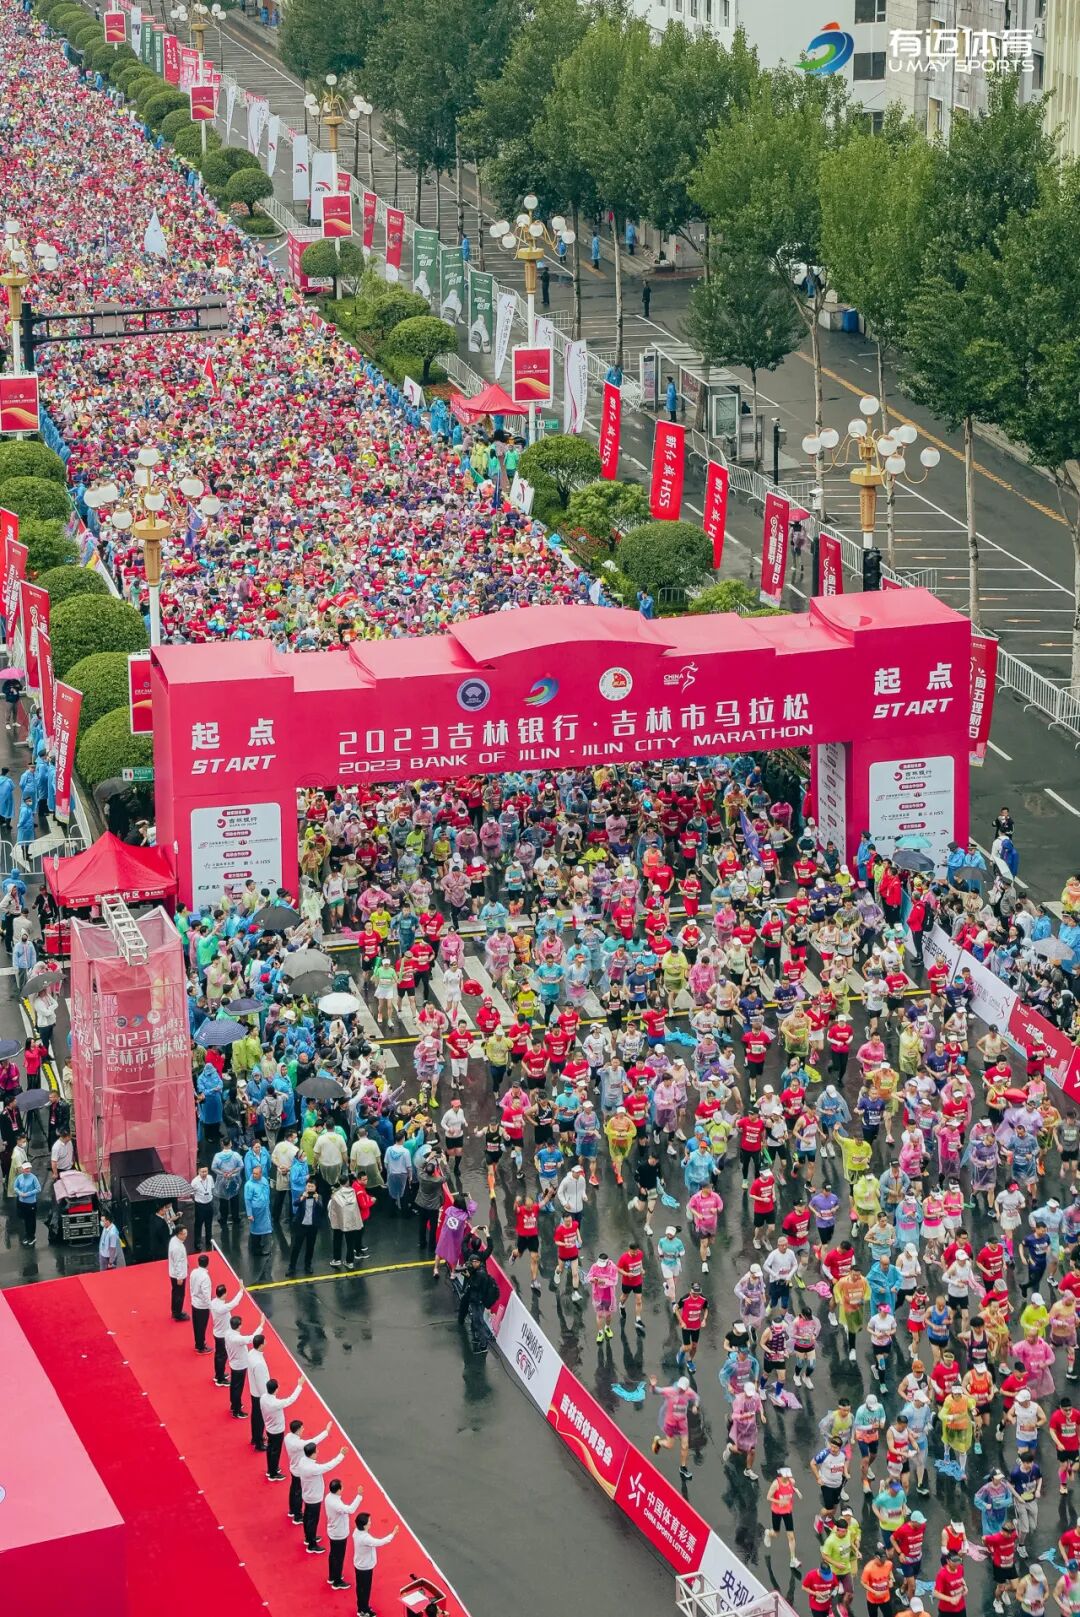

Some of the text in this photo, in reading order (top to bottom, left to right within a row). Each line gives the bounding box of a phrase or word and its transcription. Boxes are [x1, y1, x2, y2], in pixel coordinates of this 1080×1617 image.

[873, 661, 954, 696] 起点
[872, 697, 954, 719] START
[191, 717, 276, 751] 起点
[338, 724, 814, 774] 2023 BANK OF JILIN JILIN CITY MARATHON
[191, 754, 277, 775] START
[559, 1393, 614, 1467] 吉林市体育总会
[643, 1507, 692, 1564] CHINA SPORTS LOTTERY
[646, 1490, 698, 1554] 中国体育彩票
[719, 1569, 756, 1607] 央视
